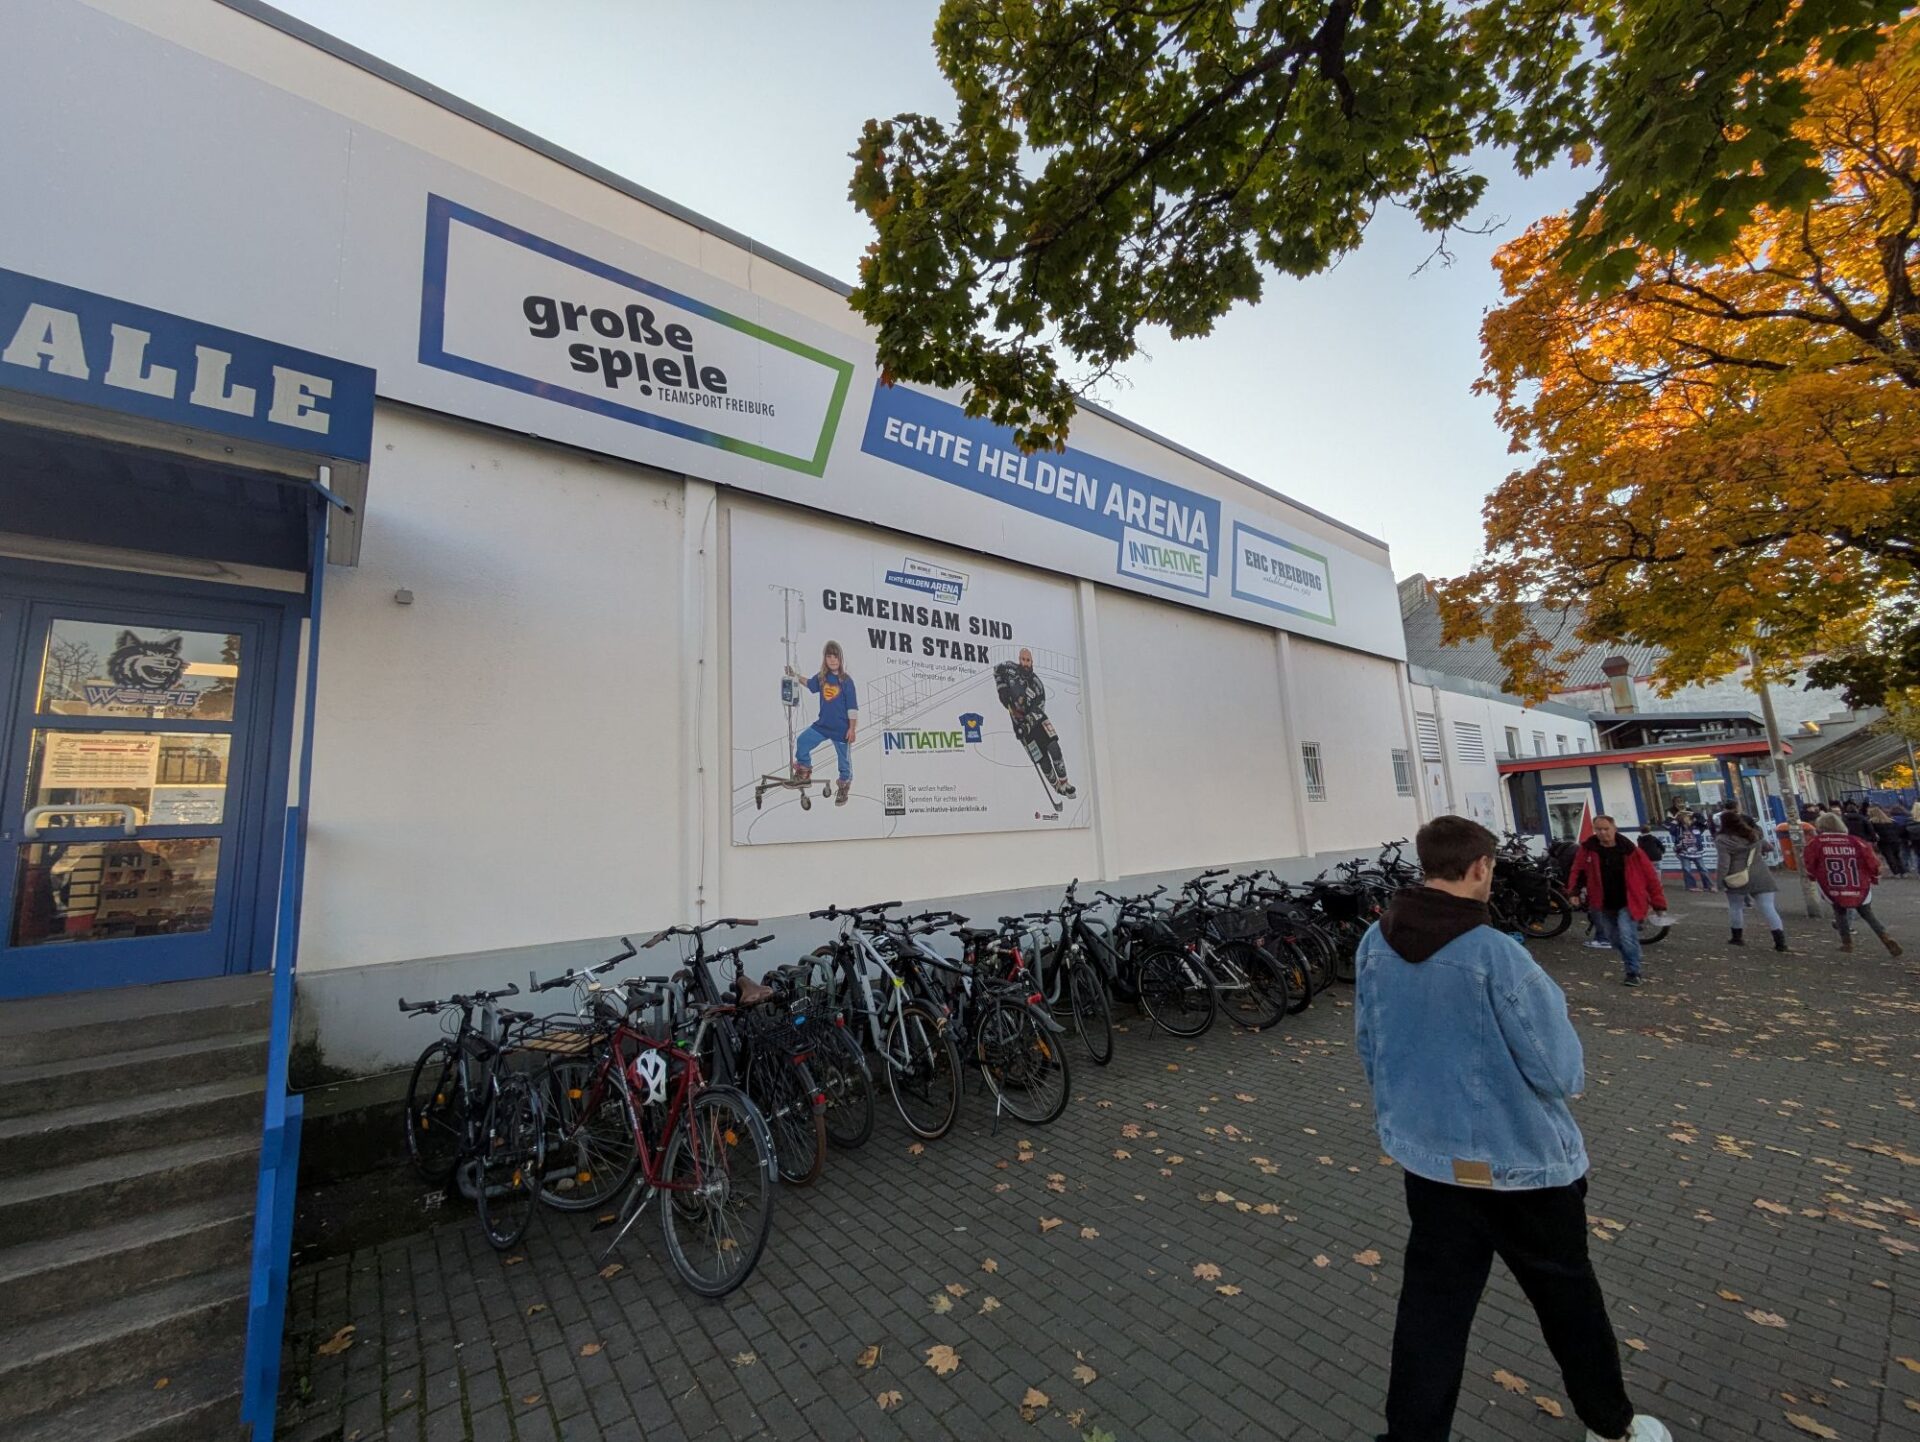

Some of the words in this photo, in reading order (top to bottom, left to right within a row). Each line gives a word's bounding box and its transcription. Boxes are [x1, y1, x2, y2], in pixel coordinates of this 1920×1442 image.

[523, 295, 693, 352] große
[2, 302, 333, 434] ALLE
[657, 387, 722, 409] TEAMSPORT
[726, 398, 775, 417] FREIBURG
[884, 417, 972, 467] ECHTE
[977, 444, 1098, 510] HELDEN
[1102, 482, 1209, 549] ARENA
[904, 577, 930, 588] HELDEN
[930, 581, 959, 594] ARENA
[1244, 549, 1268, 572] EHC
[1271, 558, 1322, 591] FREIBURG
[822, 588, 960, 635] GEMEINSAM
[969, 615, 1013, 640] SIND
[868, 628, 912, 654] WIR
[922, 637, 990, 664] STARK
[1824, 857, 1860, 887] 81
